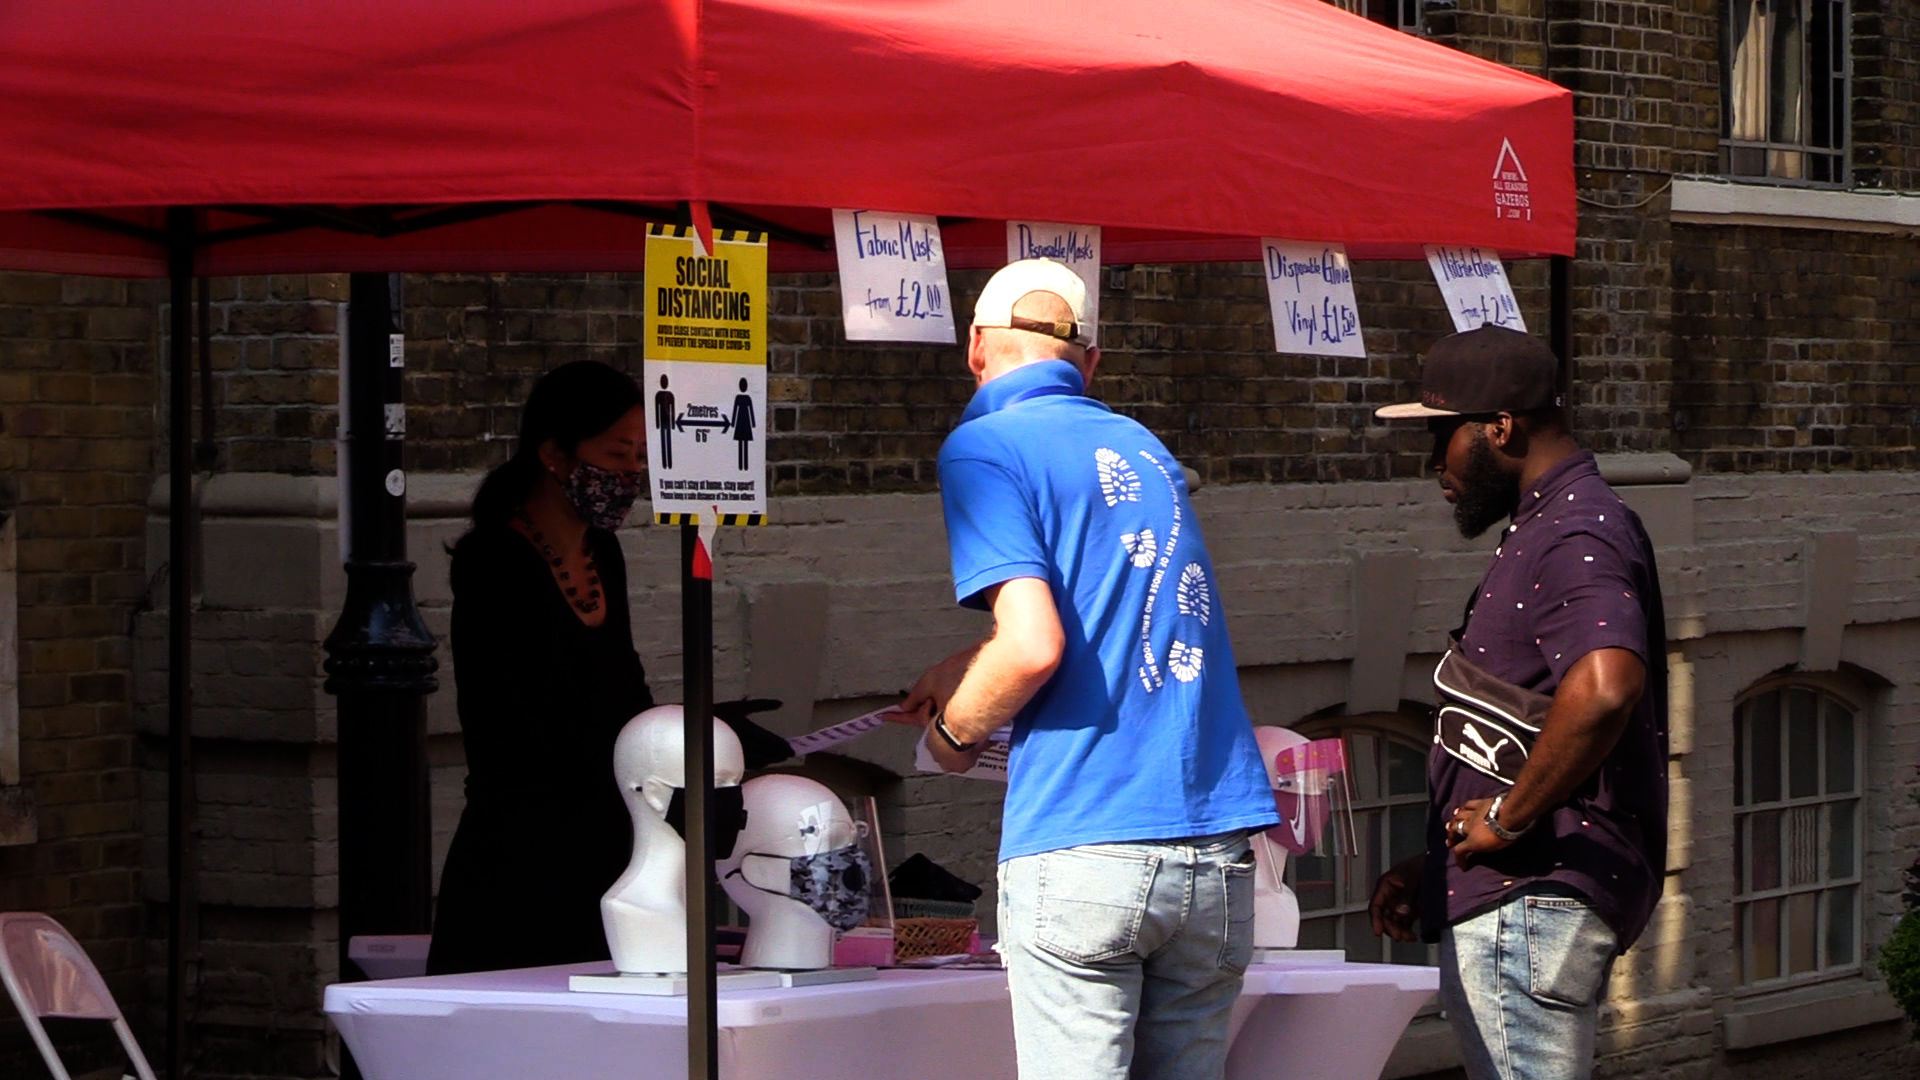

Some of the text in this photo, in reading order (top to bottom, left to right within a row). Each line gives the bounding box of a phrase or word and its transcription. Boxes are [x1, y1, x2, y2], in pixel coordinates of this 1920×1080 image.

[1494, 192, 1529, 207] GAZEBOS
[853, 210, 937, 262] Fabric Mask
[676, 256, 731, 289] SOCIAL
[657, 287, 751, 322] DISTANCING
[865, 288, 891, 318] from
[657, 325, 750, 340] AVOID CLOSE CONTACT WITH OTHERS
[1284, 300, 1318, 346] Vinyl
[657, 336, 751, 351] TO PREVENT THE SPREAD OF COVID-19
[686, 403, 719, 418] 2metres
[1138, 450, 1159, 465] HOW
[1173, 504, 1181, 521] ARE
[1170, 521, 1181, 538] THE
[1164, 537, 1178, 557] FEET
[1159, 556, 1170, 569] OF
[1149, 569, 1166, 594] THOSE
[1144, 595, 1156, 614] WHO
[1143, 641, 1156, 665] GOOD
